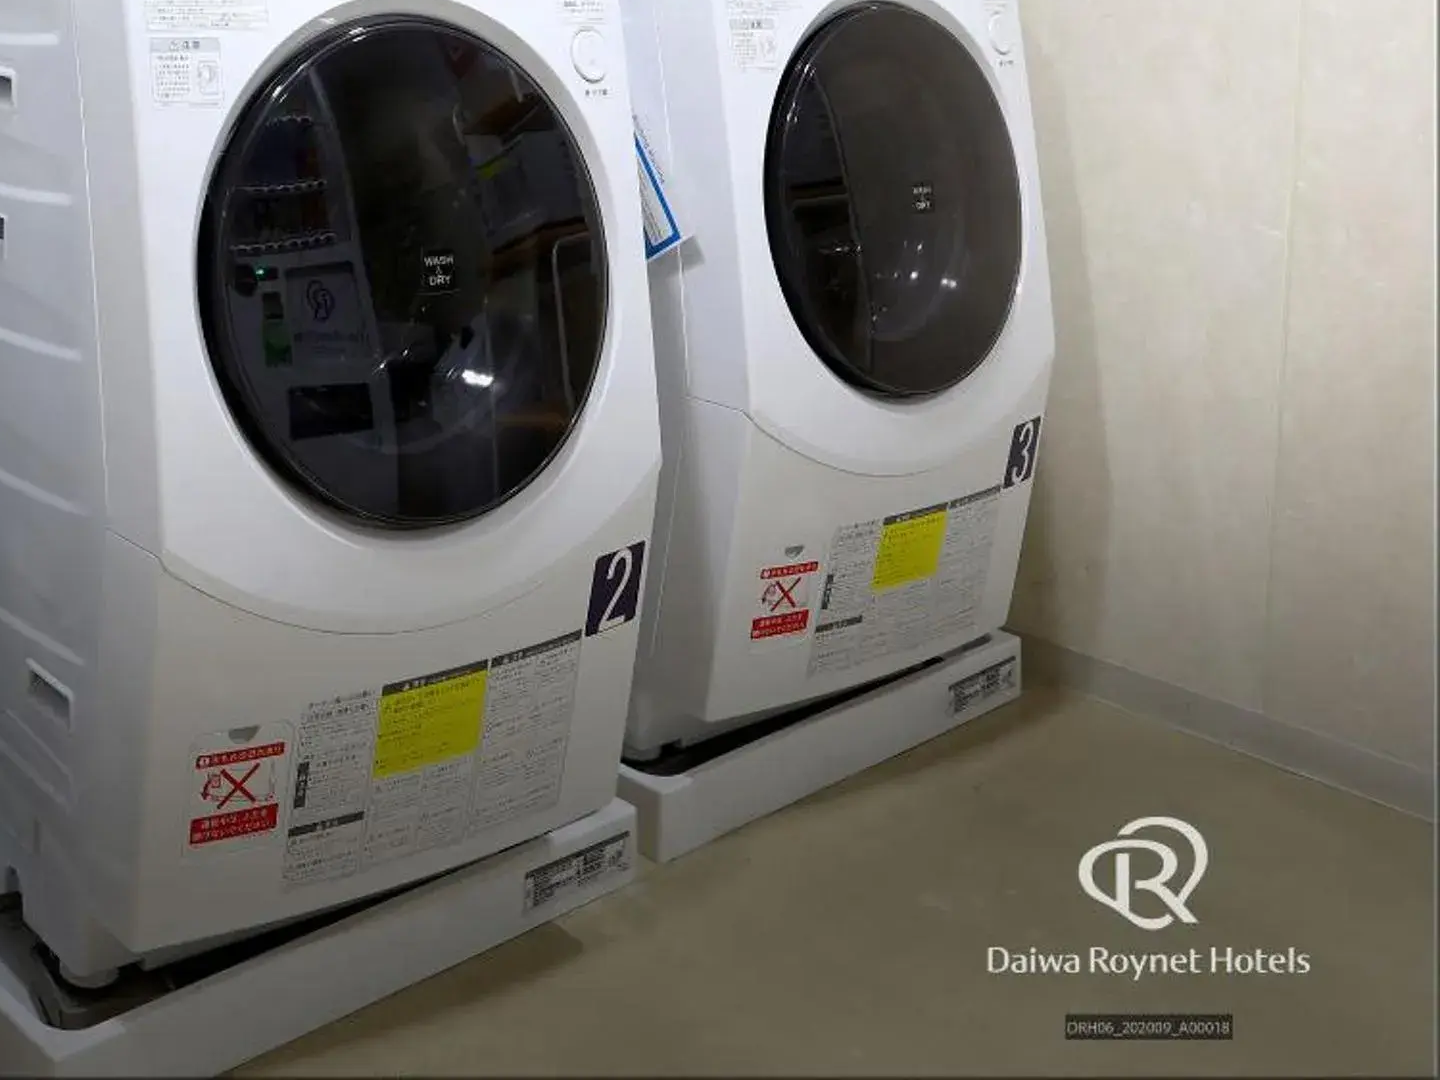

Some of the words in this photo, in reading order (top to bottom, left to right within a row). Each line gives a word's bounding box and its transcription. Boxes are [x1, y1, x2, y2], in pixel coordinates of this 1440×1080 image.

[424, 255, 453, 267] WASH
[429, 274, 450, 286] DRY
[1010, 421, 1034, 484] 3
[597, 549, 633, 632] 2
